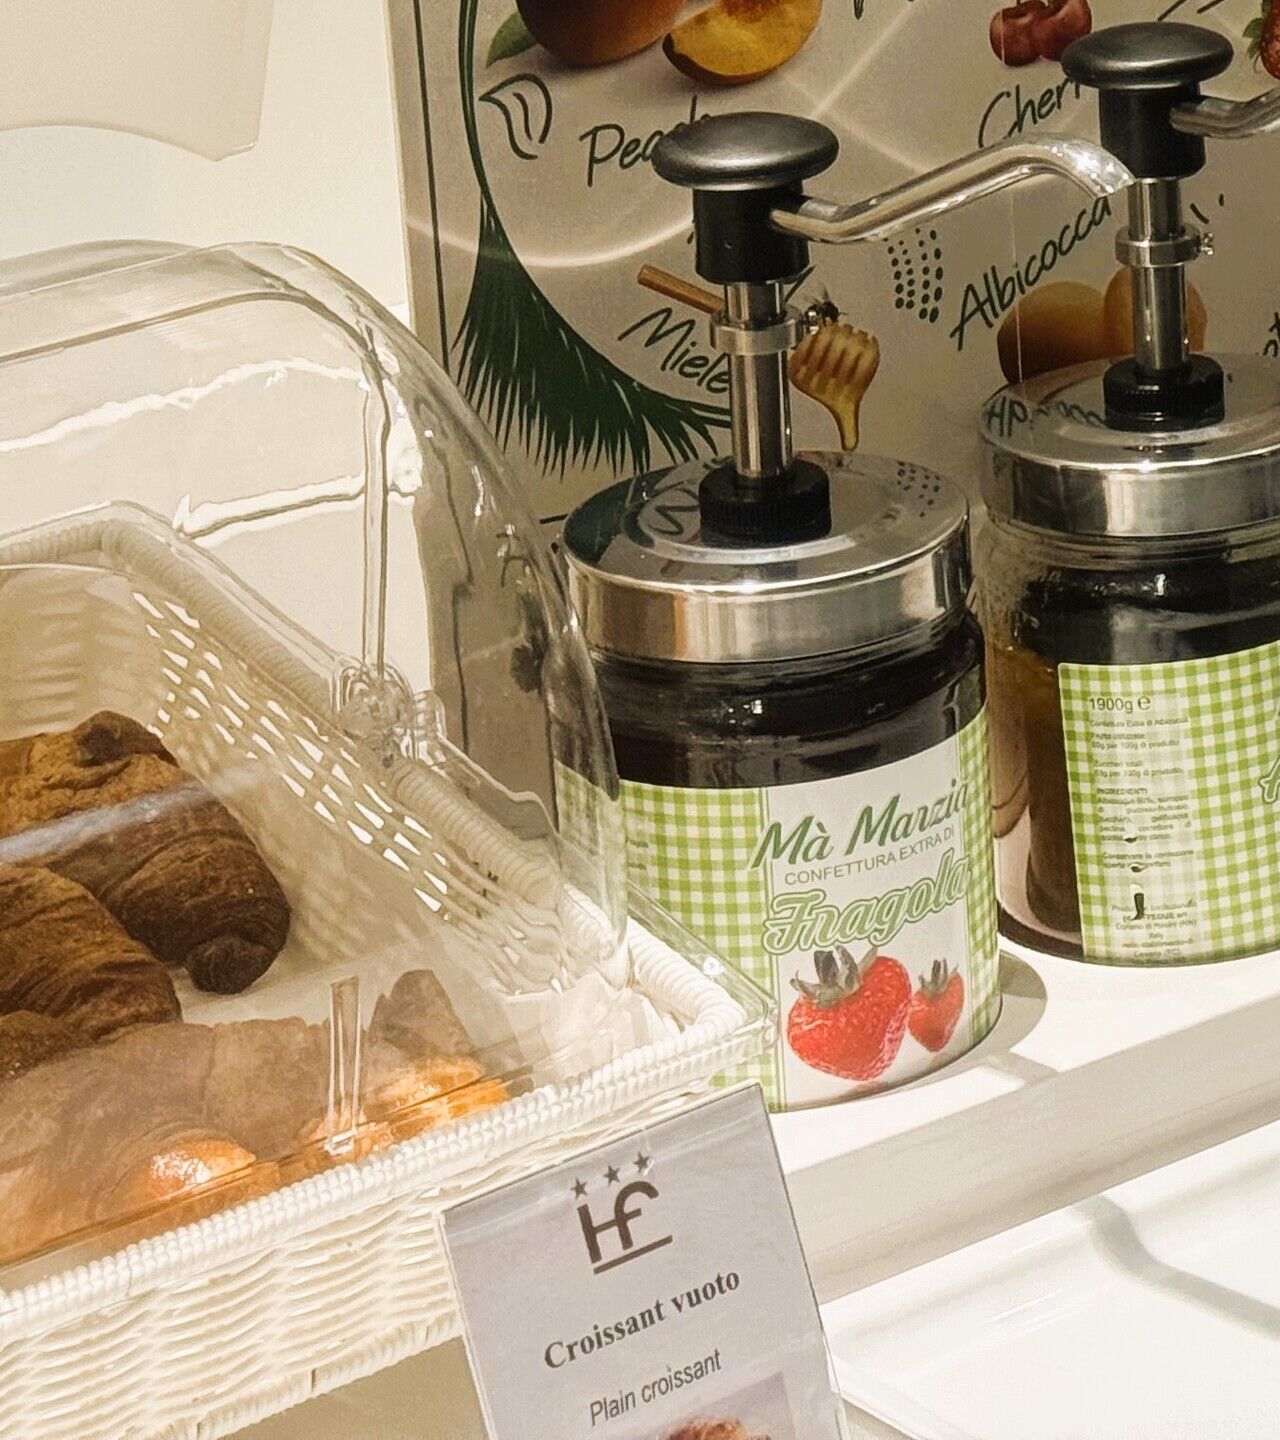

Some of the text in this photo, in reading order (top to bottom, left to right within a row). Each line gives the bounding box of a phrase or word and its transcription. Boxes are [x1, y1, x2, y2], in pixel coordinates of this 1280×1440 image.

[978, 78, 1081, 148] Cher
[617, 307, 731, 394] Miele
[1089, 697, 1133, 714] 1900g
[751, 778, 968, 869] Mà Marzia
[784, 824, 955, 886] CONFETTURA EXTRA DI
[762, 847, 971, 955] Fragola
[544, 1271, 741, 1370] Croissant vuoto
[589, 1348, 722, 1427] Plain croissant
